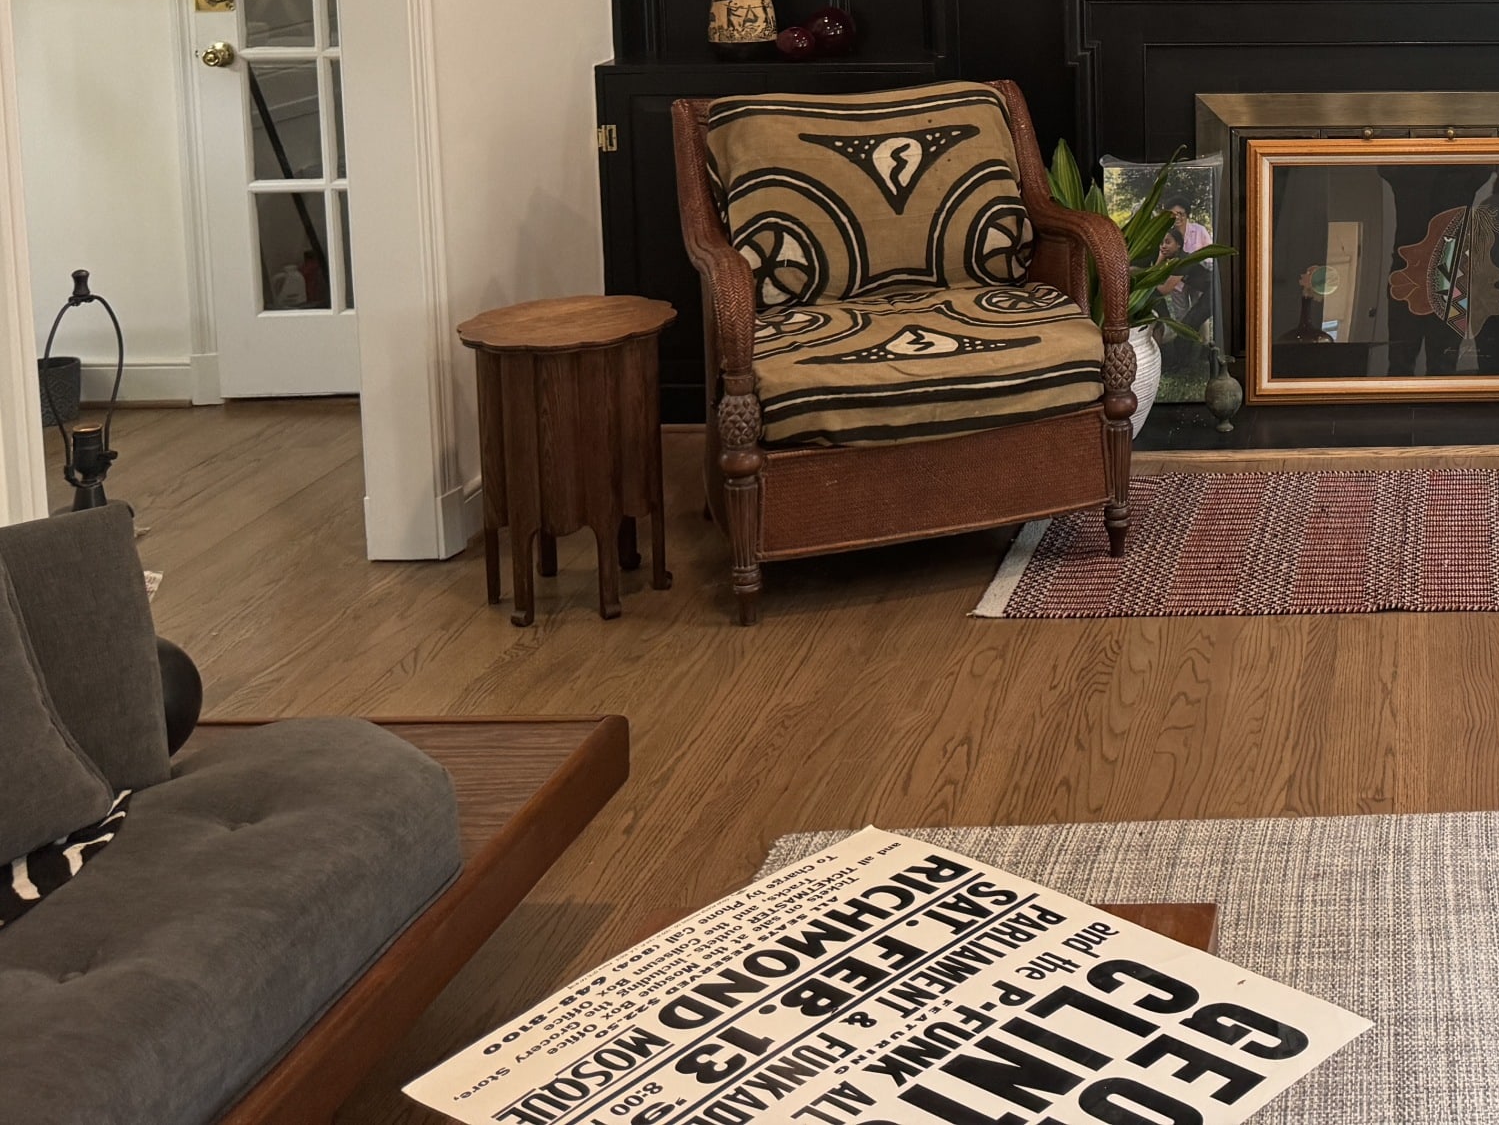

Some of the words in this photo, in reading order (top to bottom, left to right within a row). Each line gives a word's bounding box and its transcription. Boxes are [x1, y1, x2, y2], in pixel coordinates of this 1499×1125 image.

[816, 855, 838, 864] To
[857, 856, 874, 866] all
[876, 842, 902, 856] and
[762, 878, 817, 902] Tracks,
[766, 865, 815, 889] Charge
[806, 876, 860, 902] Tickets
[746, 889, 766, 900] by
[747, 867, 858, 924] TICKETMASTER
[784, 904, 803, 914] on
[810, 895, 839, 911] ALL
[905, 881, 1018, 936] SAT.
[698, 900, 745, 925] Phone
[732, 905, 759, 921] and
[752, 916, 782, 932] sale
[658, 854, 972, 1030] RICHMOND
[664, 927, 696, 944] Call
[693, 925, 743, 953] outlets
[704, 922, 730, 936] the
[730, 933, 749, 944] at
[757, 913, 808, 942] SEATS
[1061, 922, 1119, 959] and
[612, 944, 660, 972] (804)
[632, 938, 701, 975] Coliseum
[702, 946, 729, 960] the
[874, 903, 1067, 1019] PARLIAMENT
[1015, 952, 1081, 980] the
[616, 957, 687, 997] including
[638, 962, 700, 997] Mosque
[665, 943, 755, 996] RESERVED
[758, 935, 928, 1017] FEB.
[597, 978, 631, 997] Box
[483, 976, 607, 1055] 648-8100
[543, 1000, 593, 1031] Office
[584, 1001, 613, 1018] the
[594, 997, 661, 1039] $22.50
[601, 1000, 636, 1020] Box
[839, 1011, 877, 1028] &
[515, 1021, 581, 1064] Grocery
[547, 1024, 598, 1055] Office
[835, 999, 953, 1075] FEATURING
[857, 959, 1200, 1125] CLINT
[862, 980, 1047, 1087] P-FUNK
[664, 1026, 774, 1084] 13
[1037, 1002, 1309, 1125] GEO
[453, 1067, 511, 1101] Store,
[609, 1081, 663, 1116] 8:00
[791, 1080, 876, 1125] ALL
